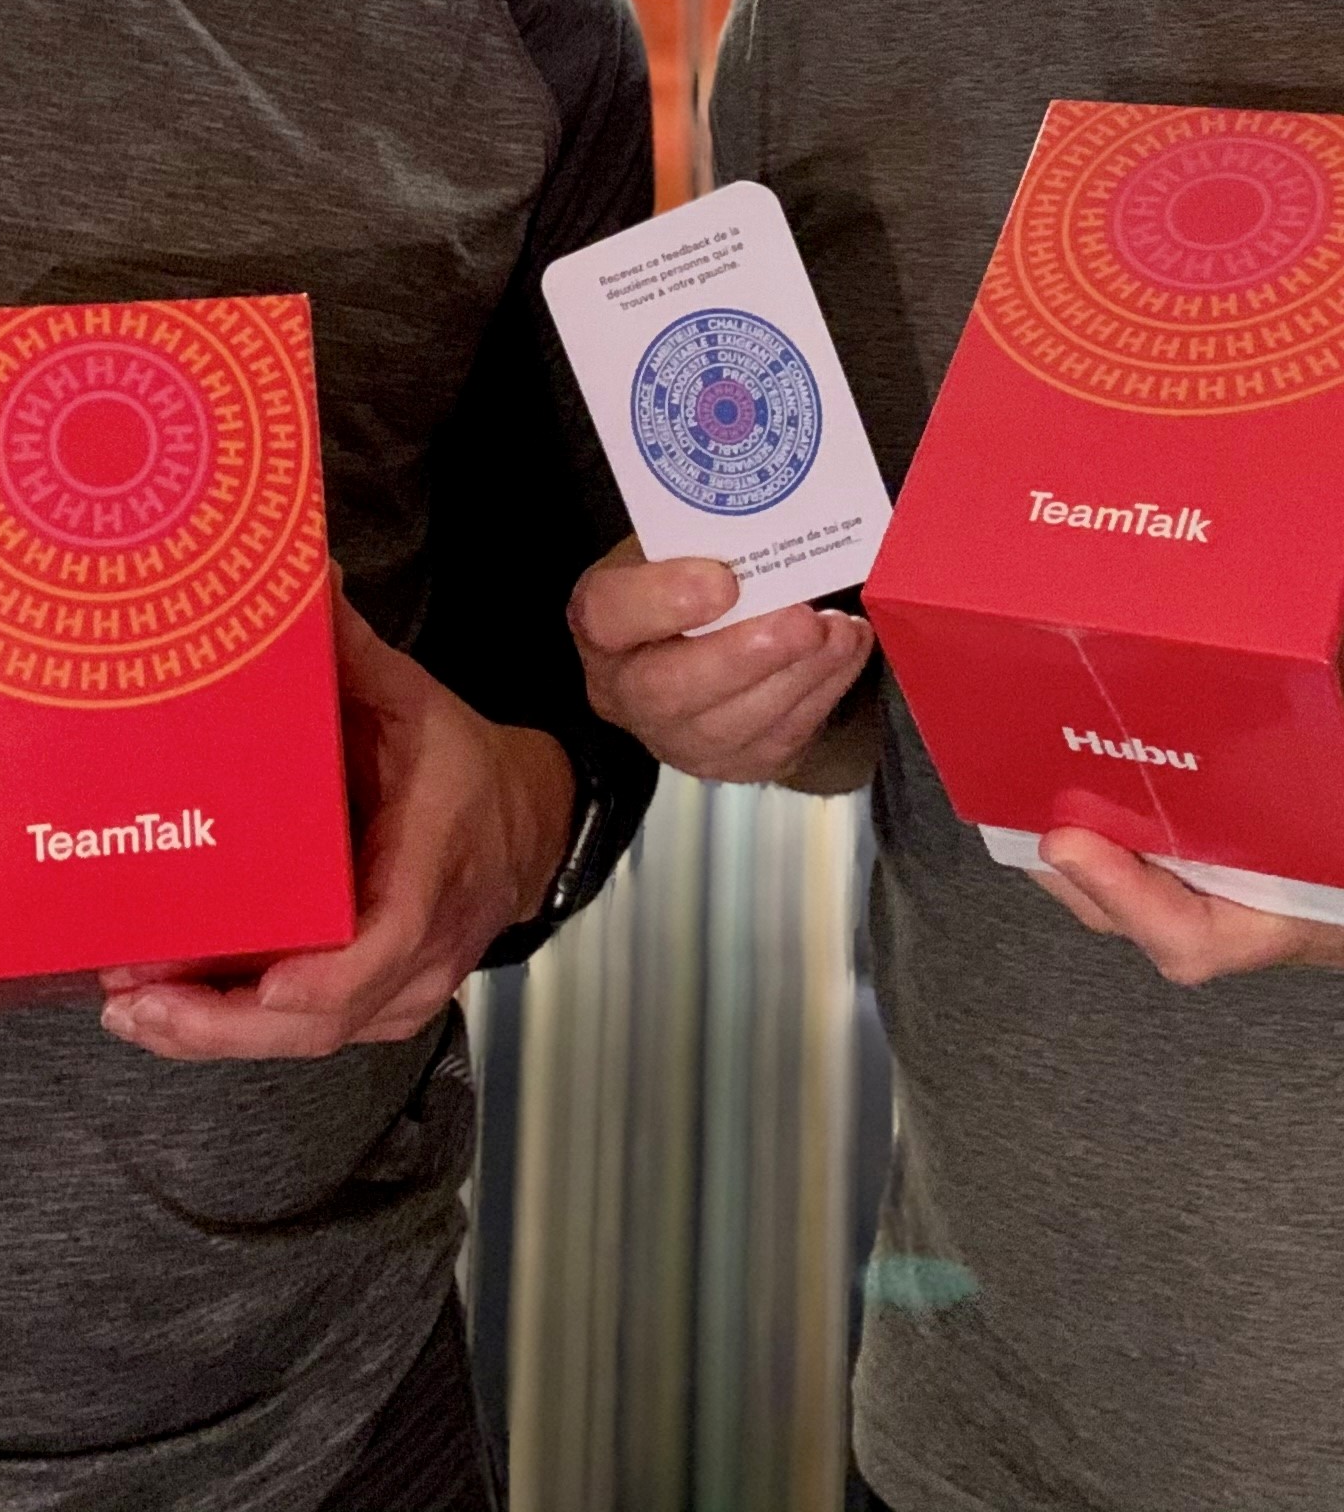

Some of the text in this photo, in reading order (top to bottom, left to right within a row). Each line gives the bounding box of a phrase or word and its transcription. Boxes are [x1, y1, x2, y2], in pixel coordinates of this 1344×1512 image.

[599, 227, 740, 286] Recevez ce feedback de la
[606, 242, 743, 300] deuxième personne qui se
[620, 292, 655, 310] trouve
[667, 277, 695, 292] votre
[697, 261, 740, 284] gauche.
[650, 323, 700, 373] AMBITIEUX
[708, 318, 785, 355] CHALEUREUX
[717, 334, 774, 366] EXIGEANT
[670, 353, 710, 405] MODESTE
[717, 350, 766, 378] OUVERT
[640, 383, 657, 446] EFFICACE
[685, 376, 704, 428] POSITIF
[776, 370, 797, 417] FRANC
[787, 360, 813, 462] COMMUNICATIF
[655, 407, 701, 479] INTELLIGENT
[671, 413, 696, 455] LOYAL
[707, 423, 764, 456] SOCIABLE
[712, 441, 774, 473] SERVIABLE
[765, 425, 796, 476] HUMBLE
[726, 467, 795, 506] COOPÉRATIF
[749, 547, 770, 561] que
[772, 535, 804, 555] j'aime
[807, 529, 821, 541] de
[823, 523, 839, 535] toi
[841, 516, 862, 530] que
[1029, 490, 1212, 543] TeamTalk
[756, 560, 781, 575] faire
[784, 551, 806, 568] plus
[1061, 726, 1199, 771] Hubu
[26, 809, 217, 863] TeamTalk
